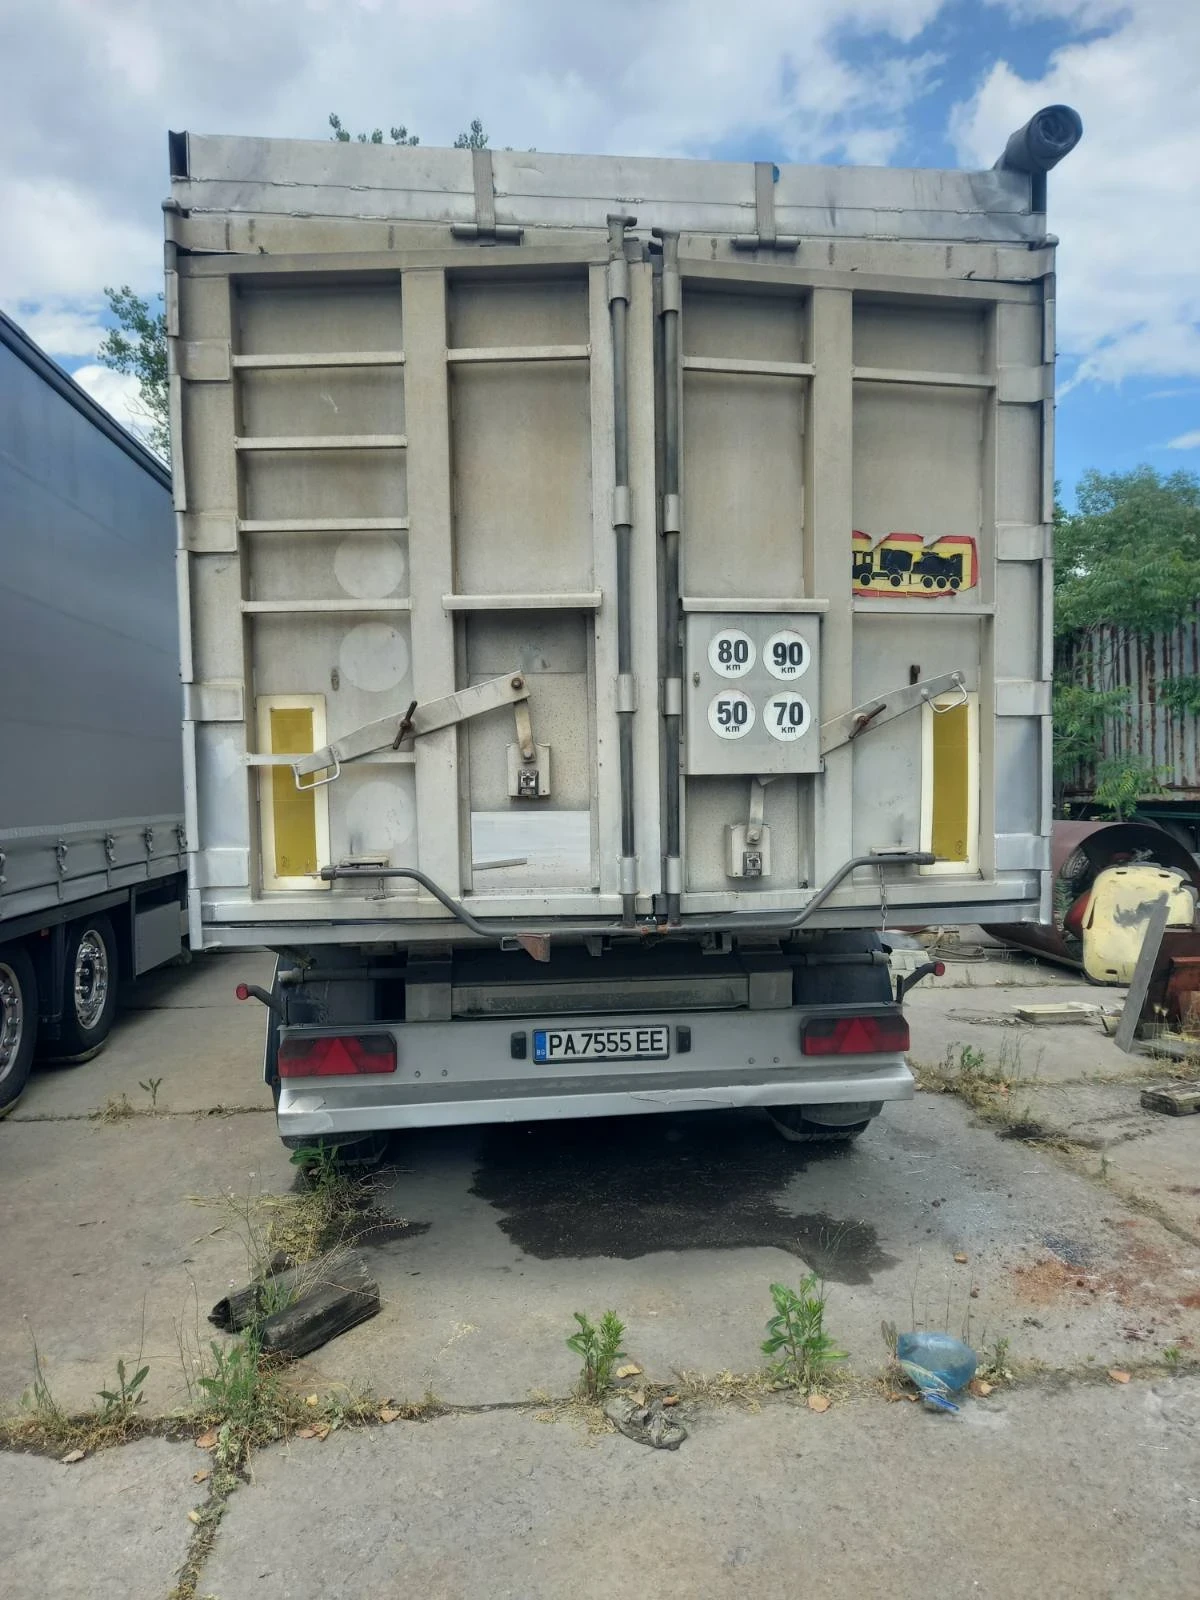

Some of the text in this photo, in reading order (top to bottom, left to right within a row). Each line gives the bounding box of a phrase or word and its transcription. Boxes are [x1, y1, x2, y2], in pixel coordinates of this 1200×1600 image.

[718, 639, 748, 663] 80
[773, 641, 803, 666] 90
[717, 701, 747, 725] 50
[773, 702, 804, 726] 70
